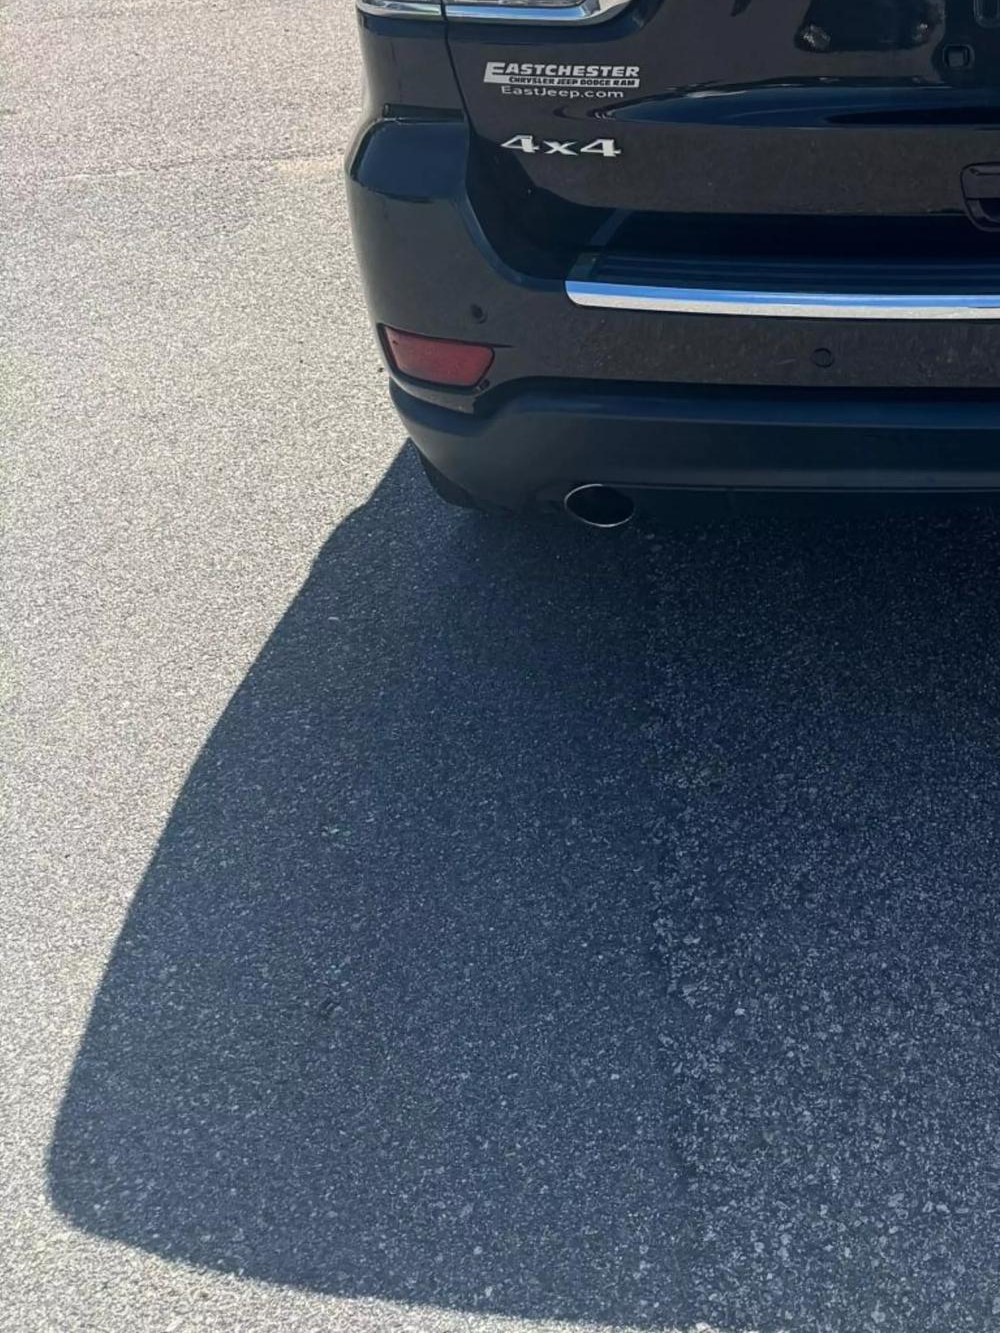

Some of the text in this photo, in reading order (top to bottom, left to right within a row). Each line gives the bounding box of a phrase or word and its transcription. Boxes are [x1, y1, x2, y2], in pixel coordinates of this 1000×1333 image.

[483, 61, 640, 79] EASTCHESTER
[508, 76, 636, 87] CHRYSLER JEEP DODGE RAM
[501, 85, 624, 98] EastJeep.com
[500, 134, 622, 158] 4x4
